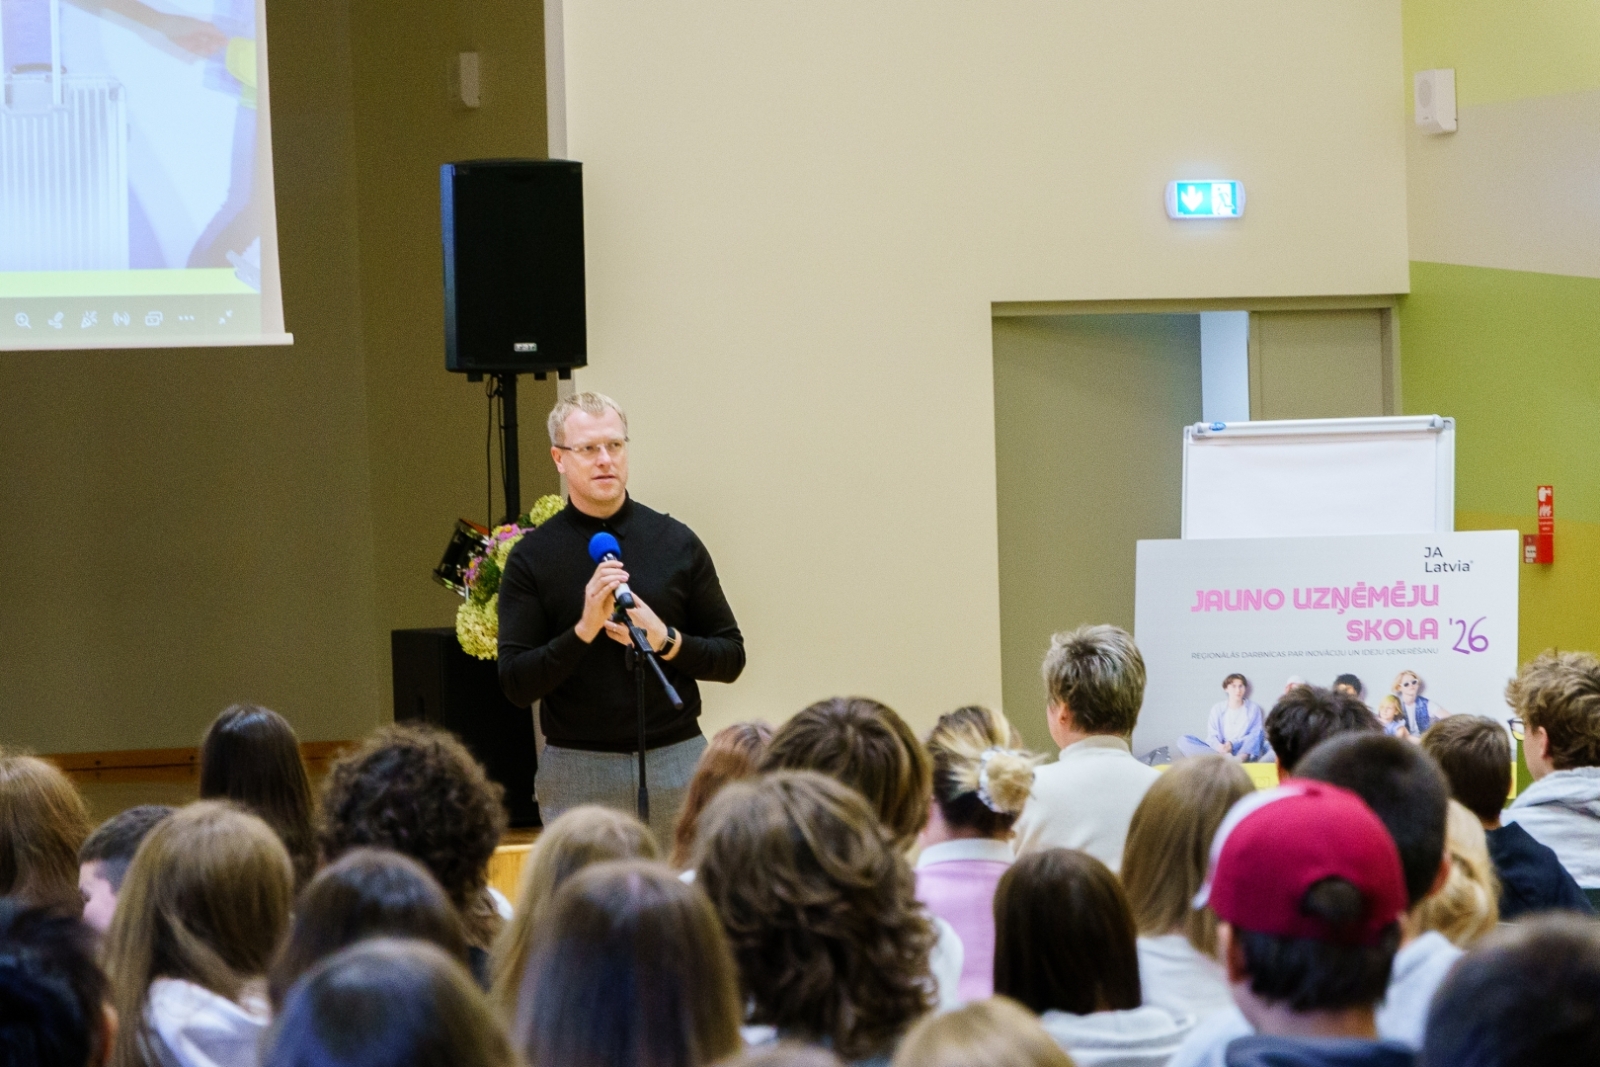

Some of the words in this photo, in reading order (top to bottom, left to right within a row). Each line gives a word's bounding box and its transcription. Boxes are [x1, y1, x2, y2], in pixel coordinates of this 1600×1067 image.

[1424, 546, 1443, 558] JA
[1425, 560, 1471, 573] Latvia
[1191, 588, 1285, 612] JAUNO
[1293, 580, 1439, 615] UZŅĒMĒJU
[1346, 618, 1439, 642] SKOLA
[1361, 648, 1384, 656] IDEJU
